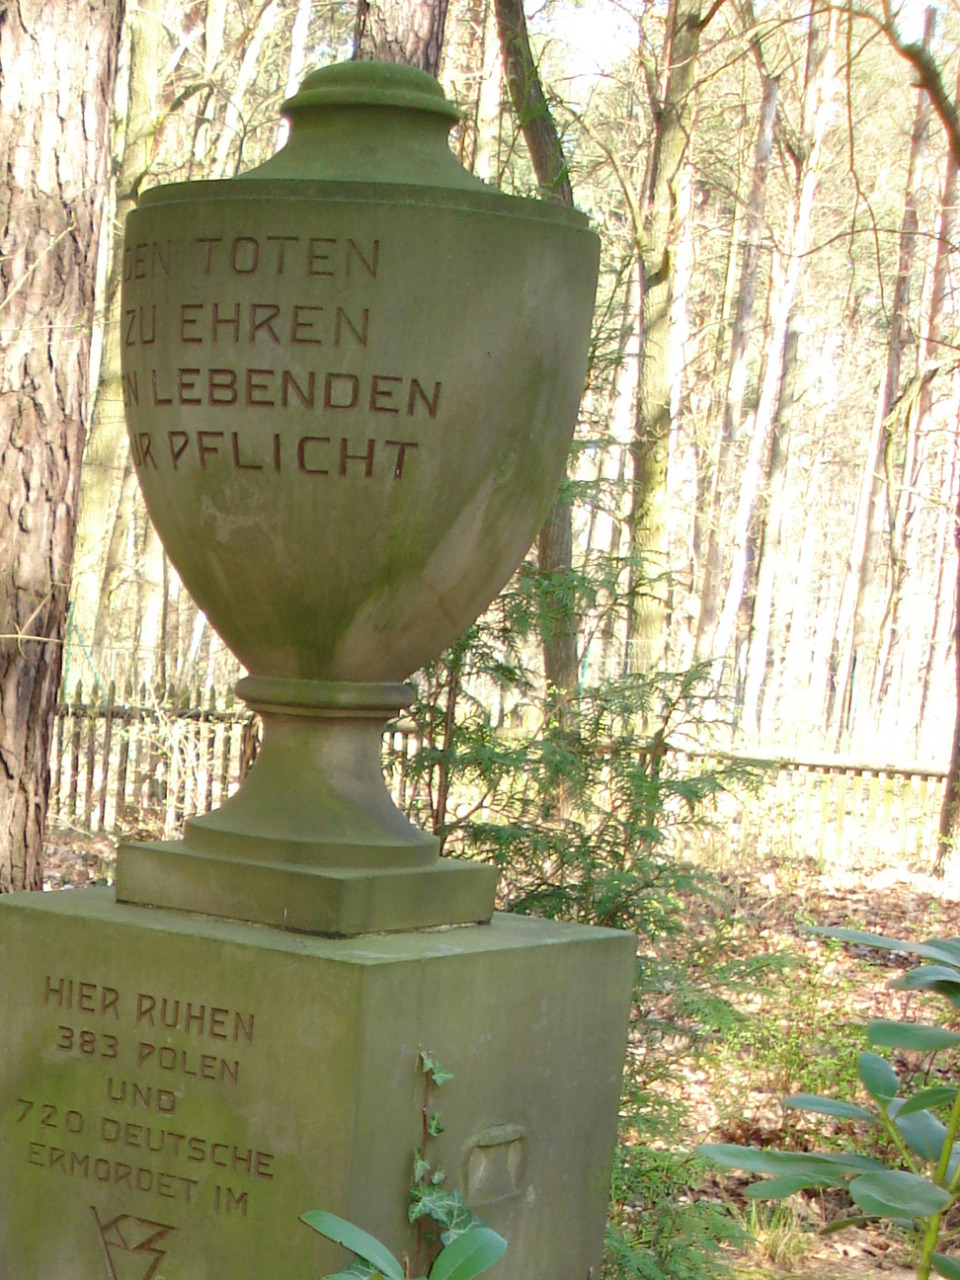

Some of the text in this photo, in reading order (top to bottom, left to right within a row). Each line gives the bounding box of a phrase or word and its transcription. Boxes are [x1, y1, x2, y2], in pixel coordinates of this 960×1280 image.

[195, 236, 380, 279] TOTEN
[124, 303, 370, 348] ZU EHREN
[152, 368, 442, 418] LEBENDEN
[167, 430, 419, 480] PFLICHT
[44, 976, 255, 1043] HIER RUHEN
[56, 1025, 240, 1085] 383 POLEN
[107, 1078, 177, 1116] UND
[16, 1098, 275, 1180] 720 DEUTSCHE
[27, 1141, 248, 1217] ERMORDET IM
